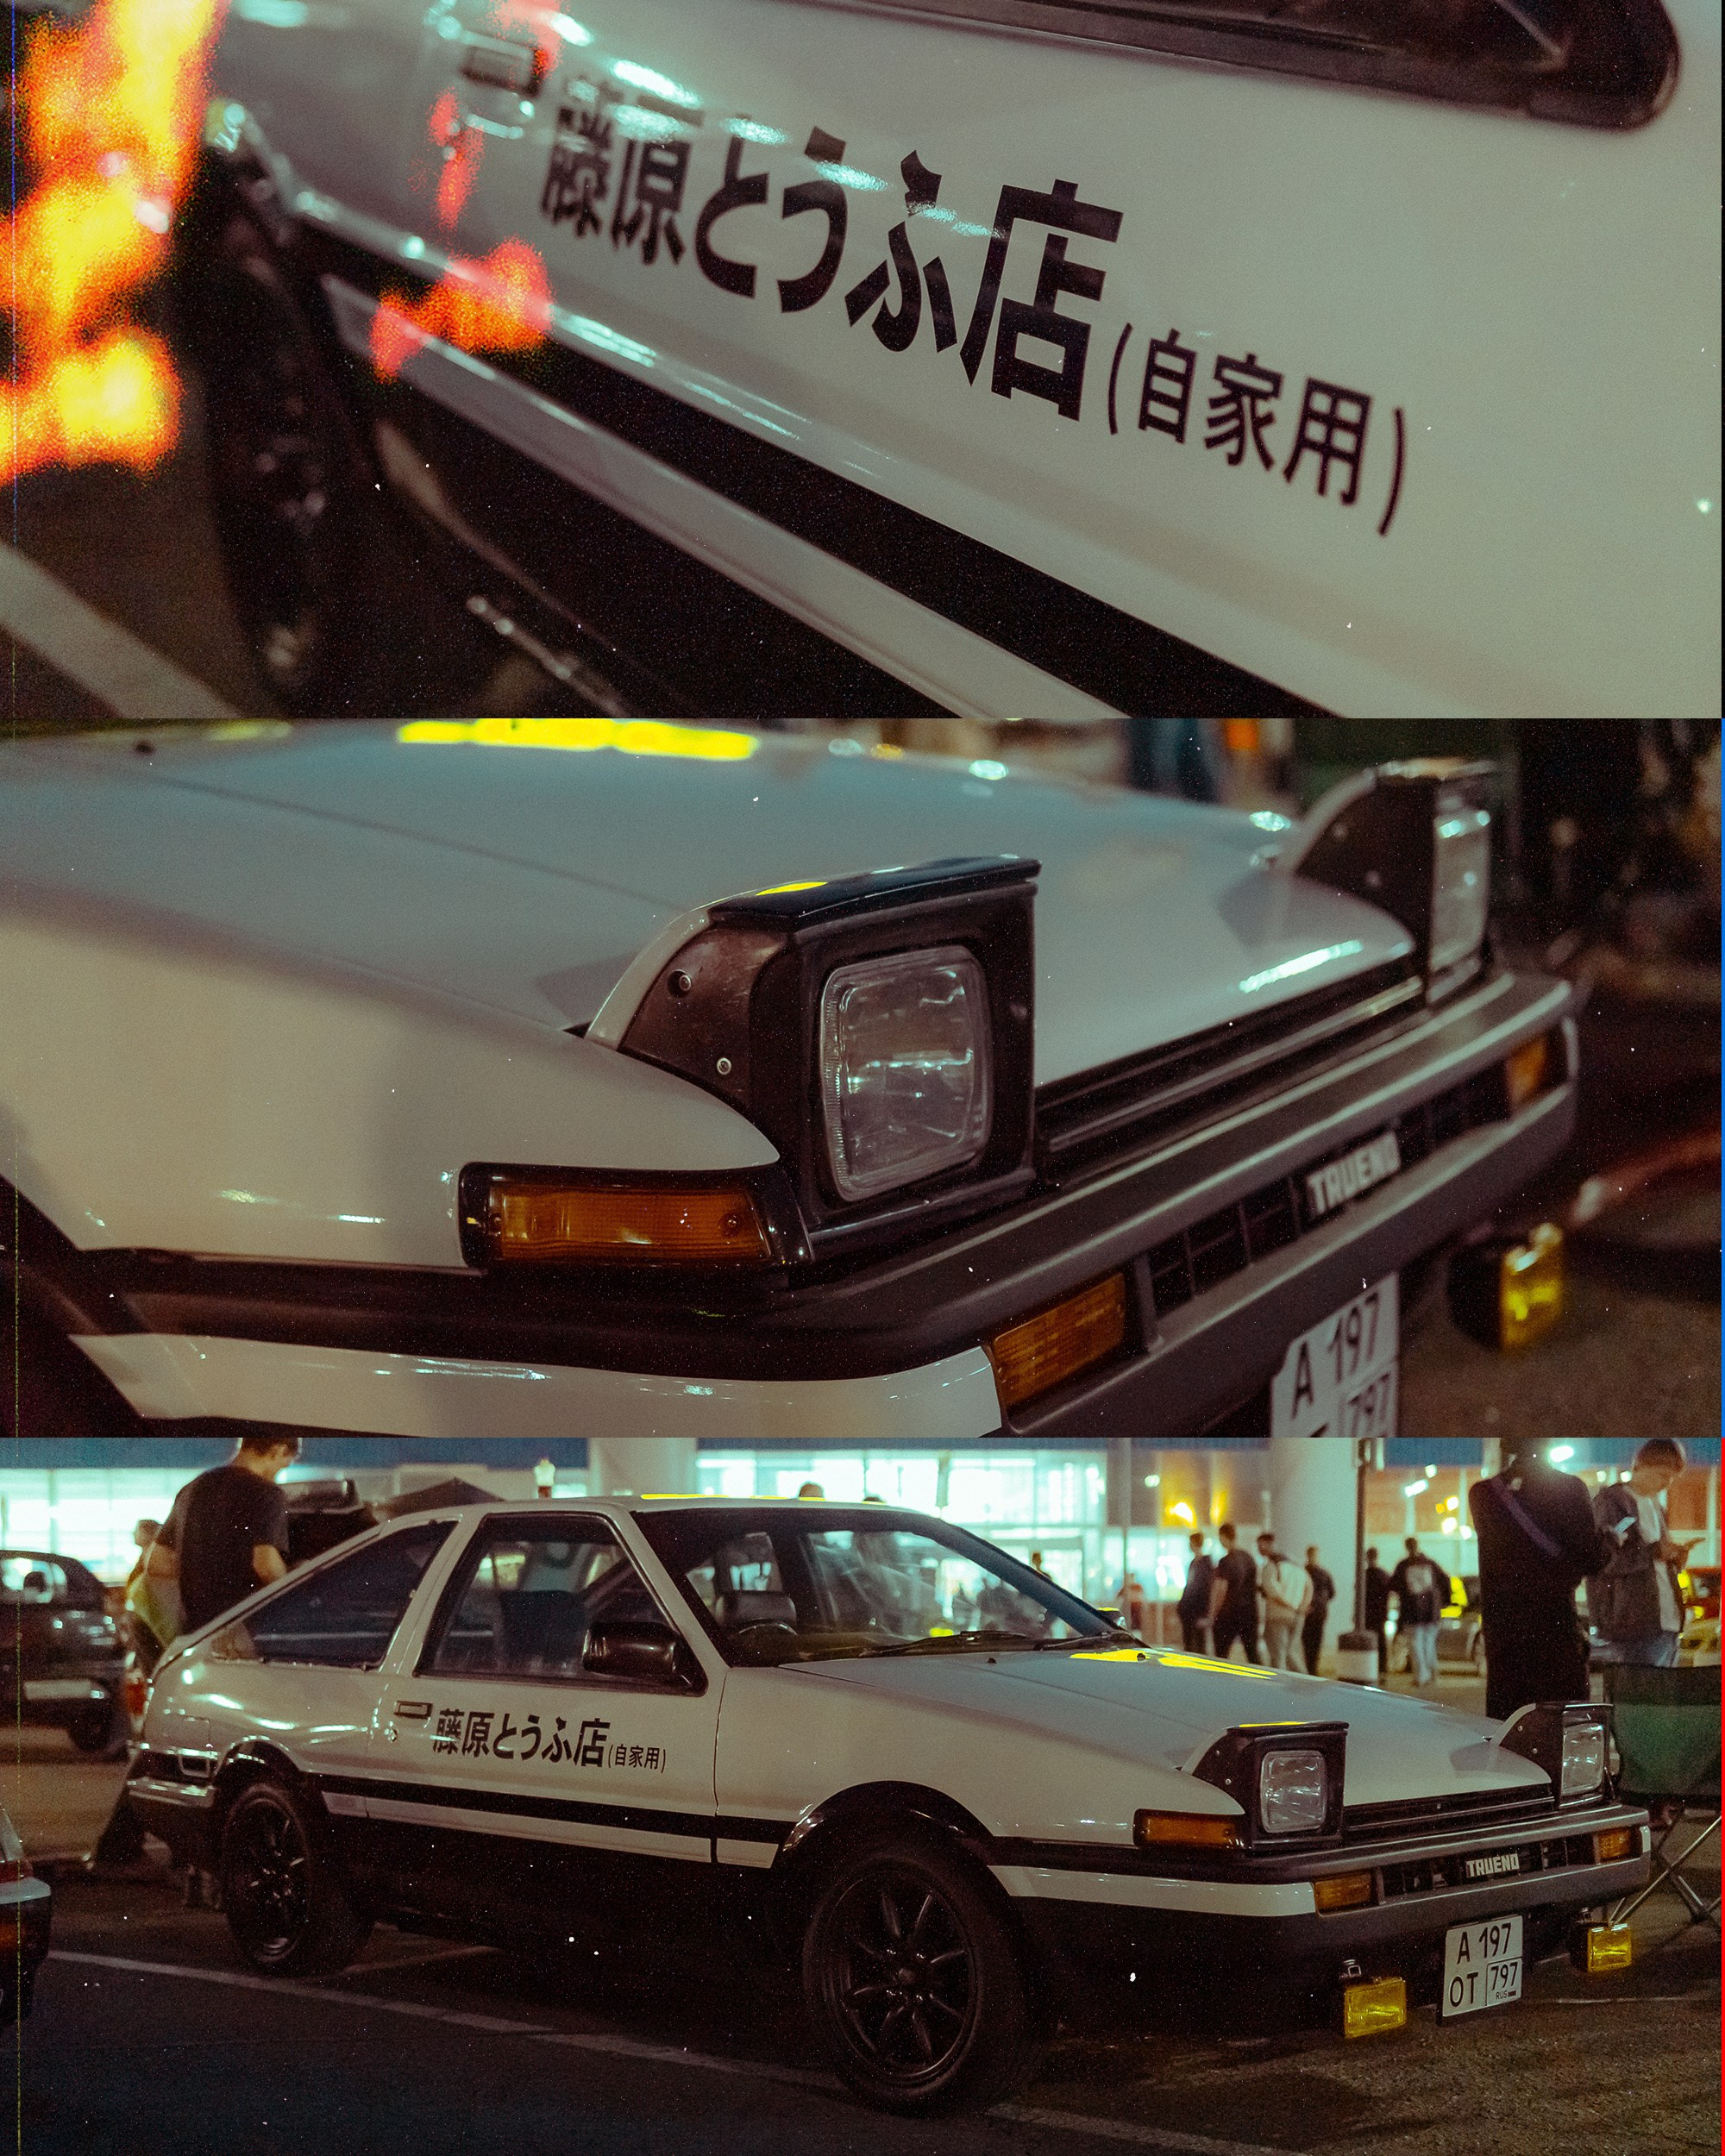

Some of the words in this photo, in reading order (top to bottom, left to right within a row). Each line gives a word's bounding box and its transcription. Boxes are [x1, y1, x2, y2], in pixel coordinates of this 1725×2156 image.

[1292, 1341, 1314, 1419] A
[1327, 1293, 1378, 1384] 197
[1466, 1853, 1520, 1877] TRUENO
[1457, 1932, 1471, 1965] A
[1478, 1922, 1511, 1959] 197
[1450, 1971, 1479, 2008] OT
[1490, 1961, 1519, 1990] 797
[1496, 1990, 1508, 2000] RUS
